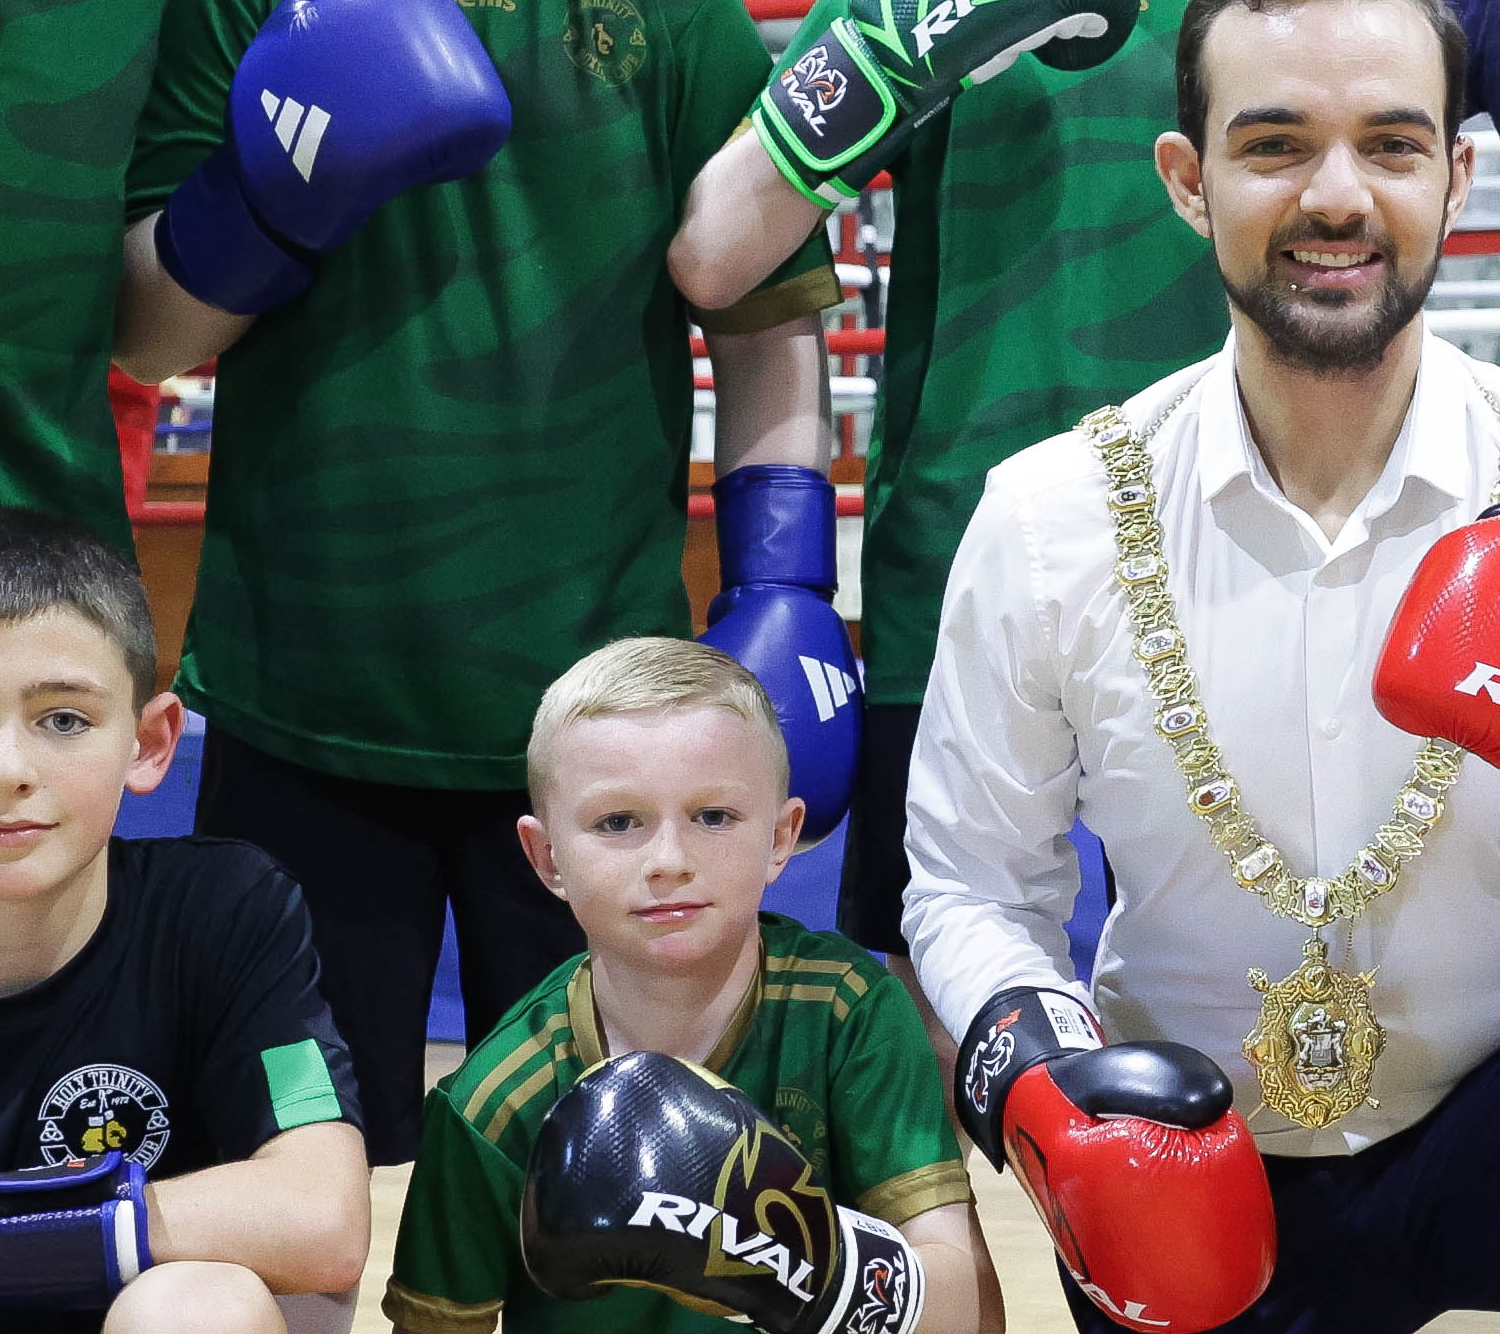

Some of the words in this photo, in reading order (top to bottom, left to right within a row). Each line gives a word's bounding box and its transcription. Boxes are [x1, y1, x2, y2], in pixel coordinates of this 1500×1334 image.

[1050, 1006, 1072, 1035] RB7
[50, 1071, 86, 1111] HOLY
[87, 1071, 154, 1104] TRINITY
[627, 1191, 818, 1303] RIVAL
